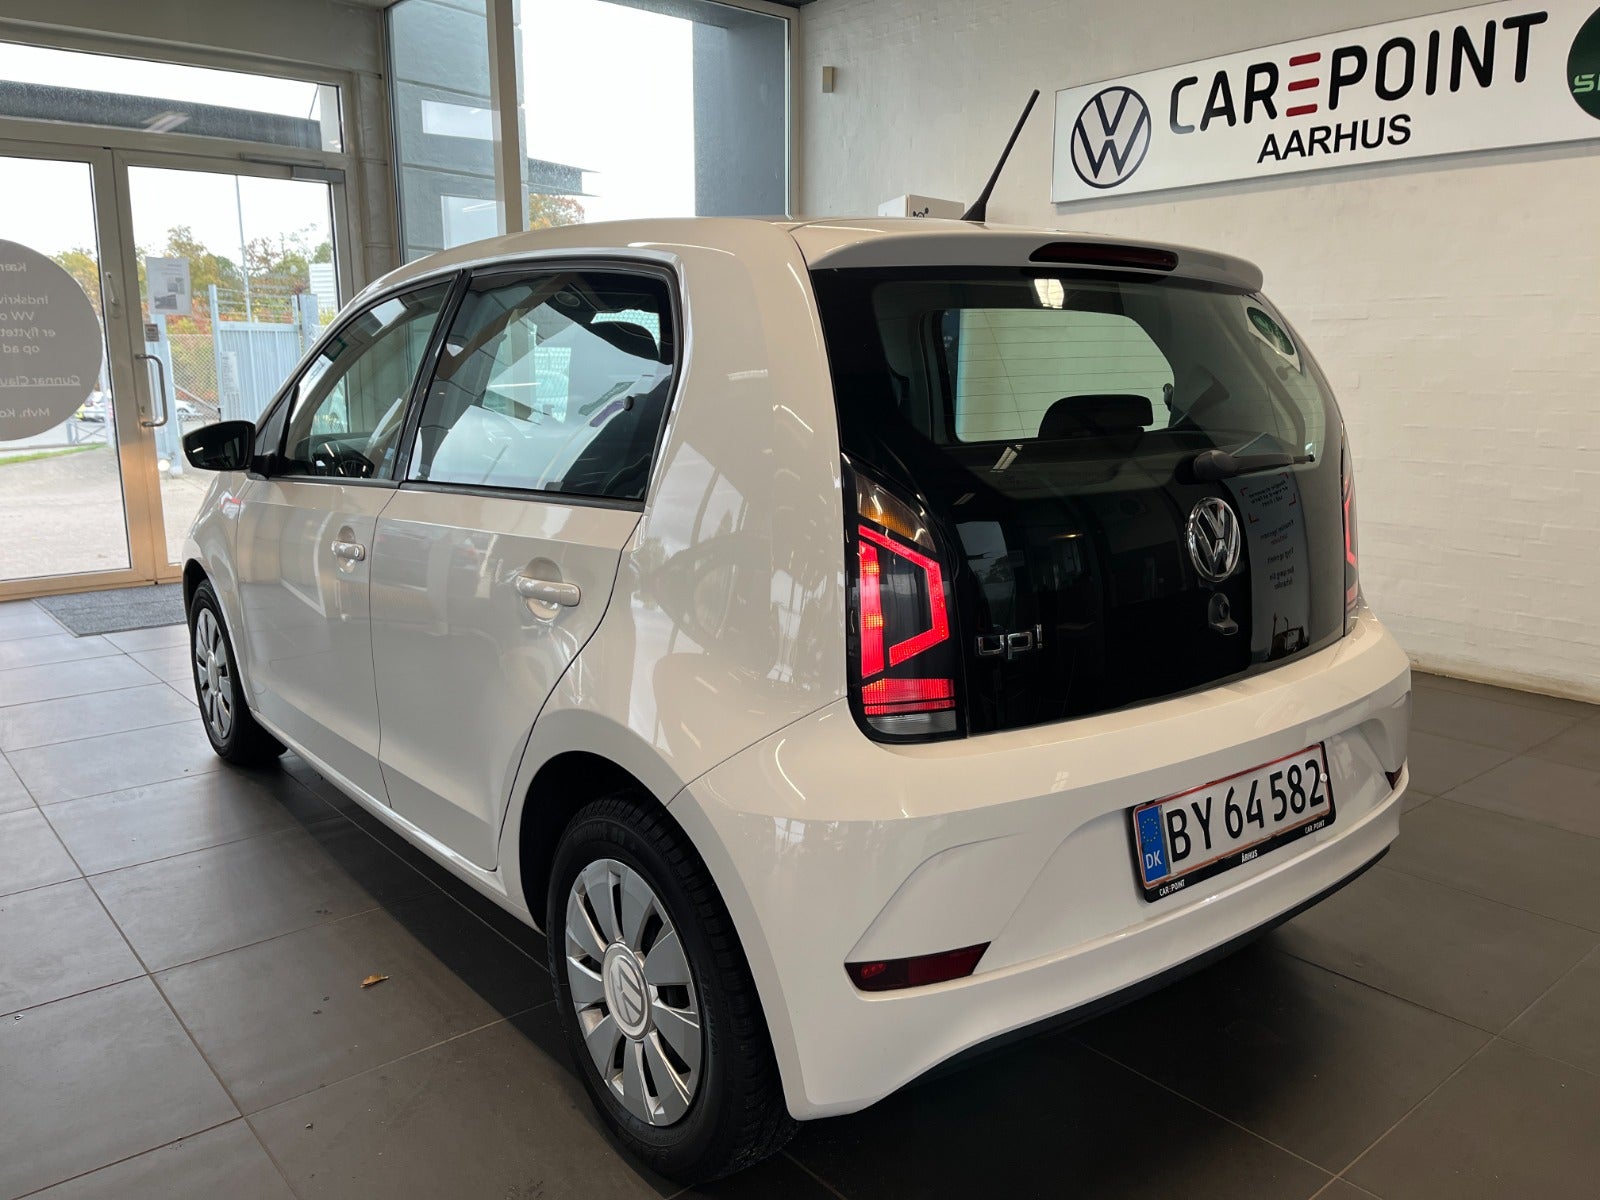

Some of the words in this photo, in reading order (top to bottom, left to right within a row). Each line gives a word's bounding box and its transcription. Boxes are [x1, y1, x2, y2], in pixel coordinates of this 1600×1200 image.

[1572, 73, 1600, 93] S
[1070, 86, 1152, 189] VW
[1256, 113, 1412, 164] AARHUS
[1186, 497, 1241, 582] VW
[977, 624, 1043, 660] up!
[1166, 796, 1212, 863] BY
[1145, 849, 1162, 870] DK
